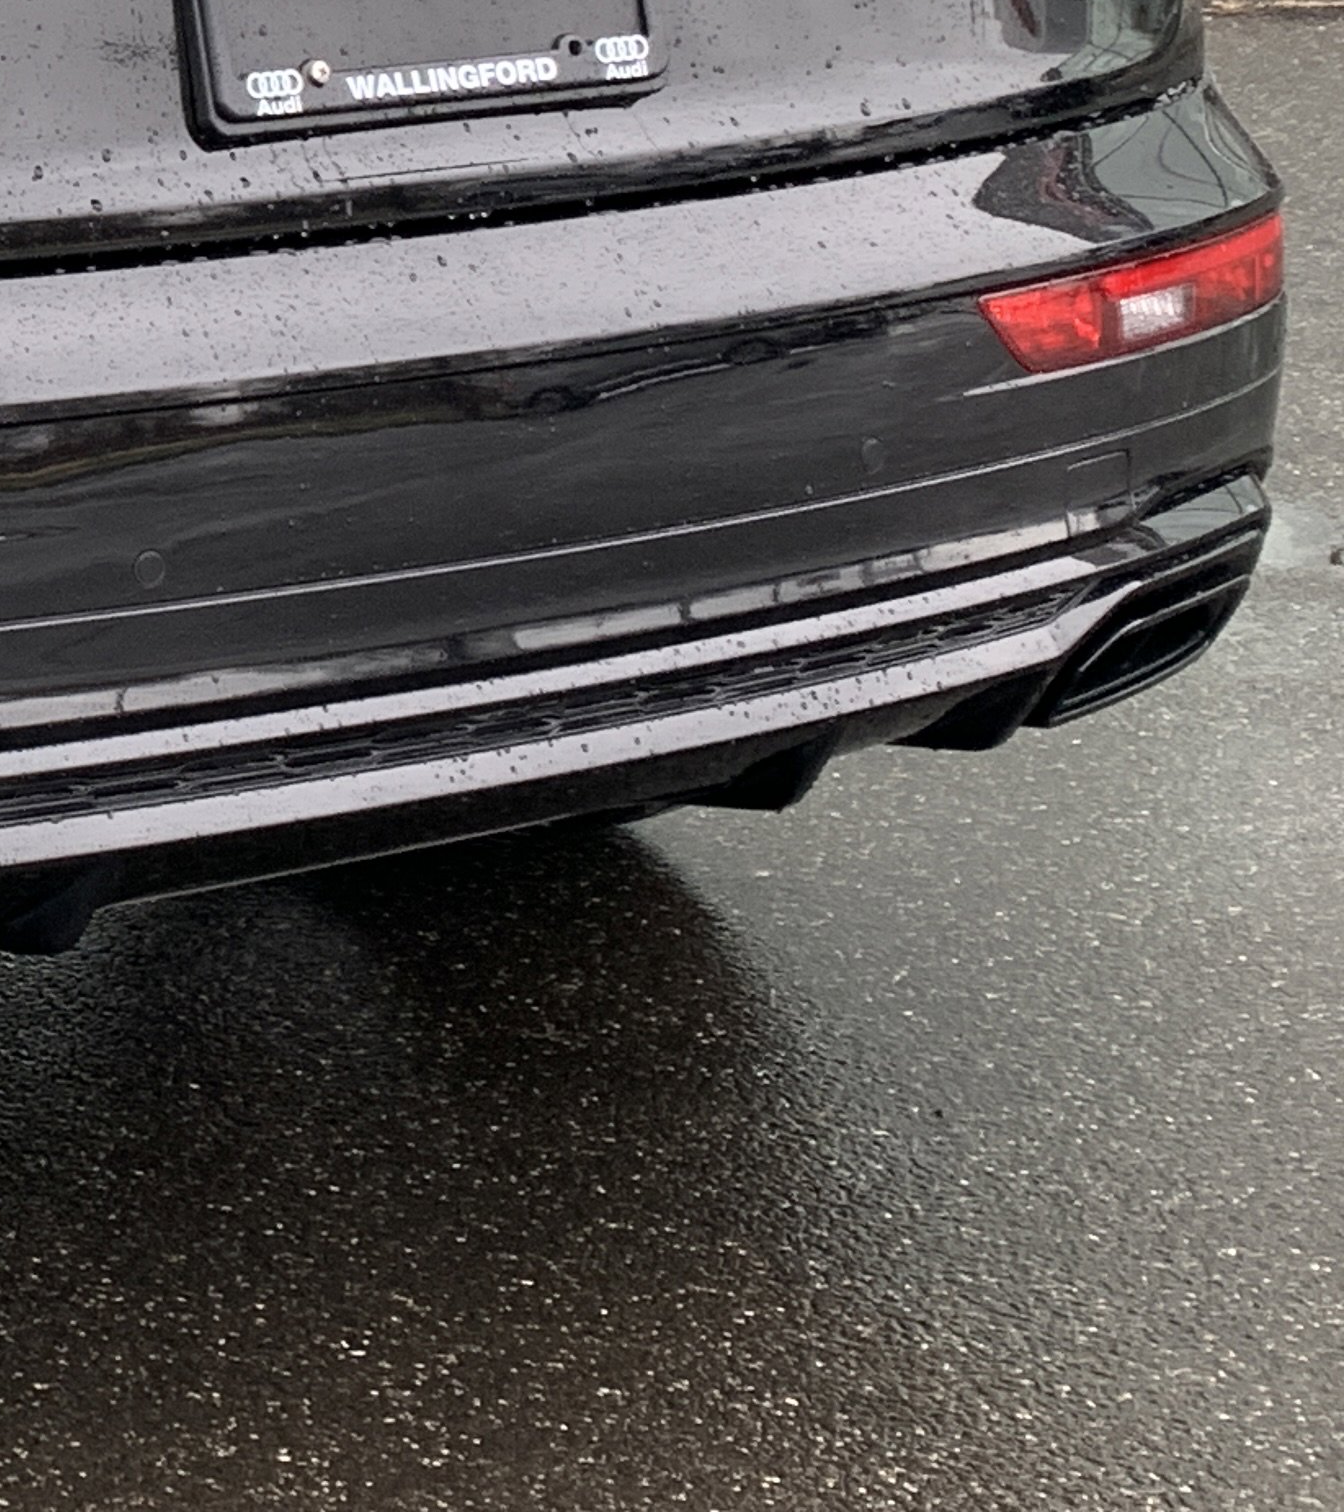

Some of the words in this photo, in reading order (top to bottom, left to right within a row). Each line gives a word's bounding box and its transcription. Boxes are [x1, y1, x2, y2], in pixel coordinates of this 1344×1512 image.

[346, 56, 558, 101] WALLINGFORD
[605, 59, 649, 80] Audi
[256, 95, 303, 117] Audi
